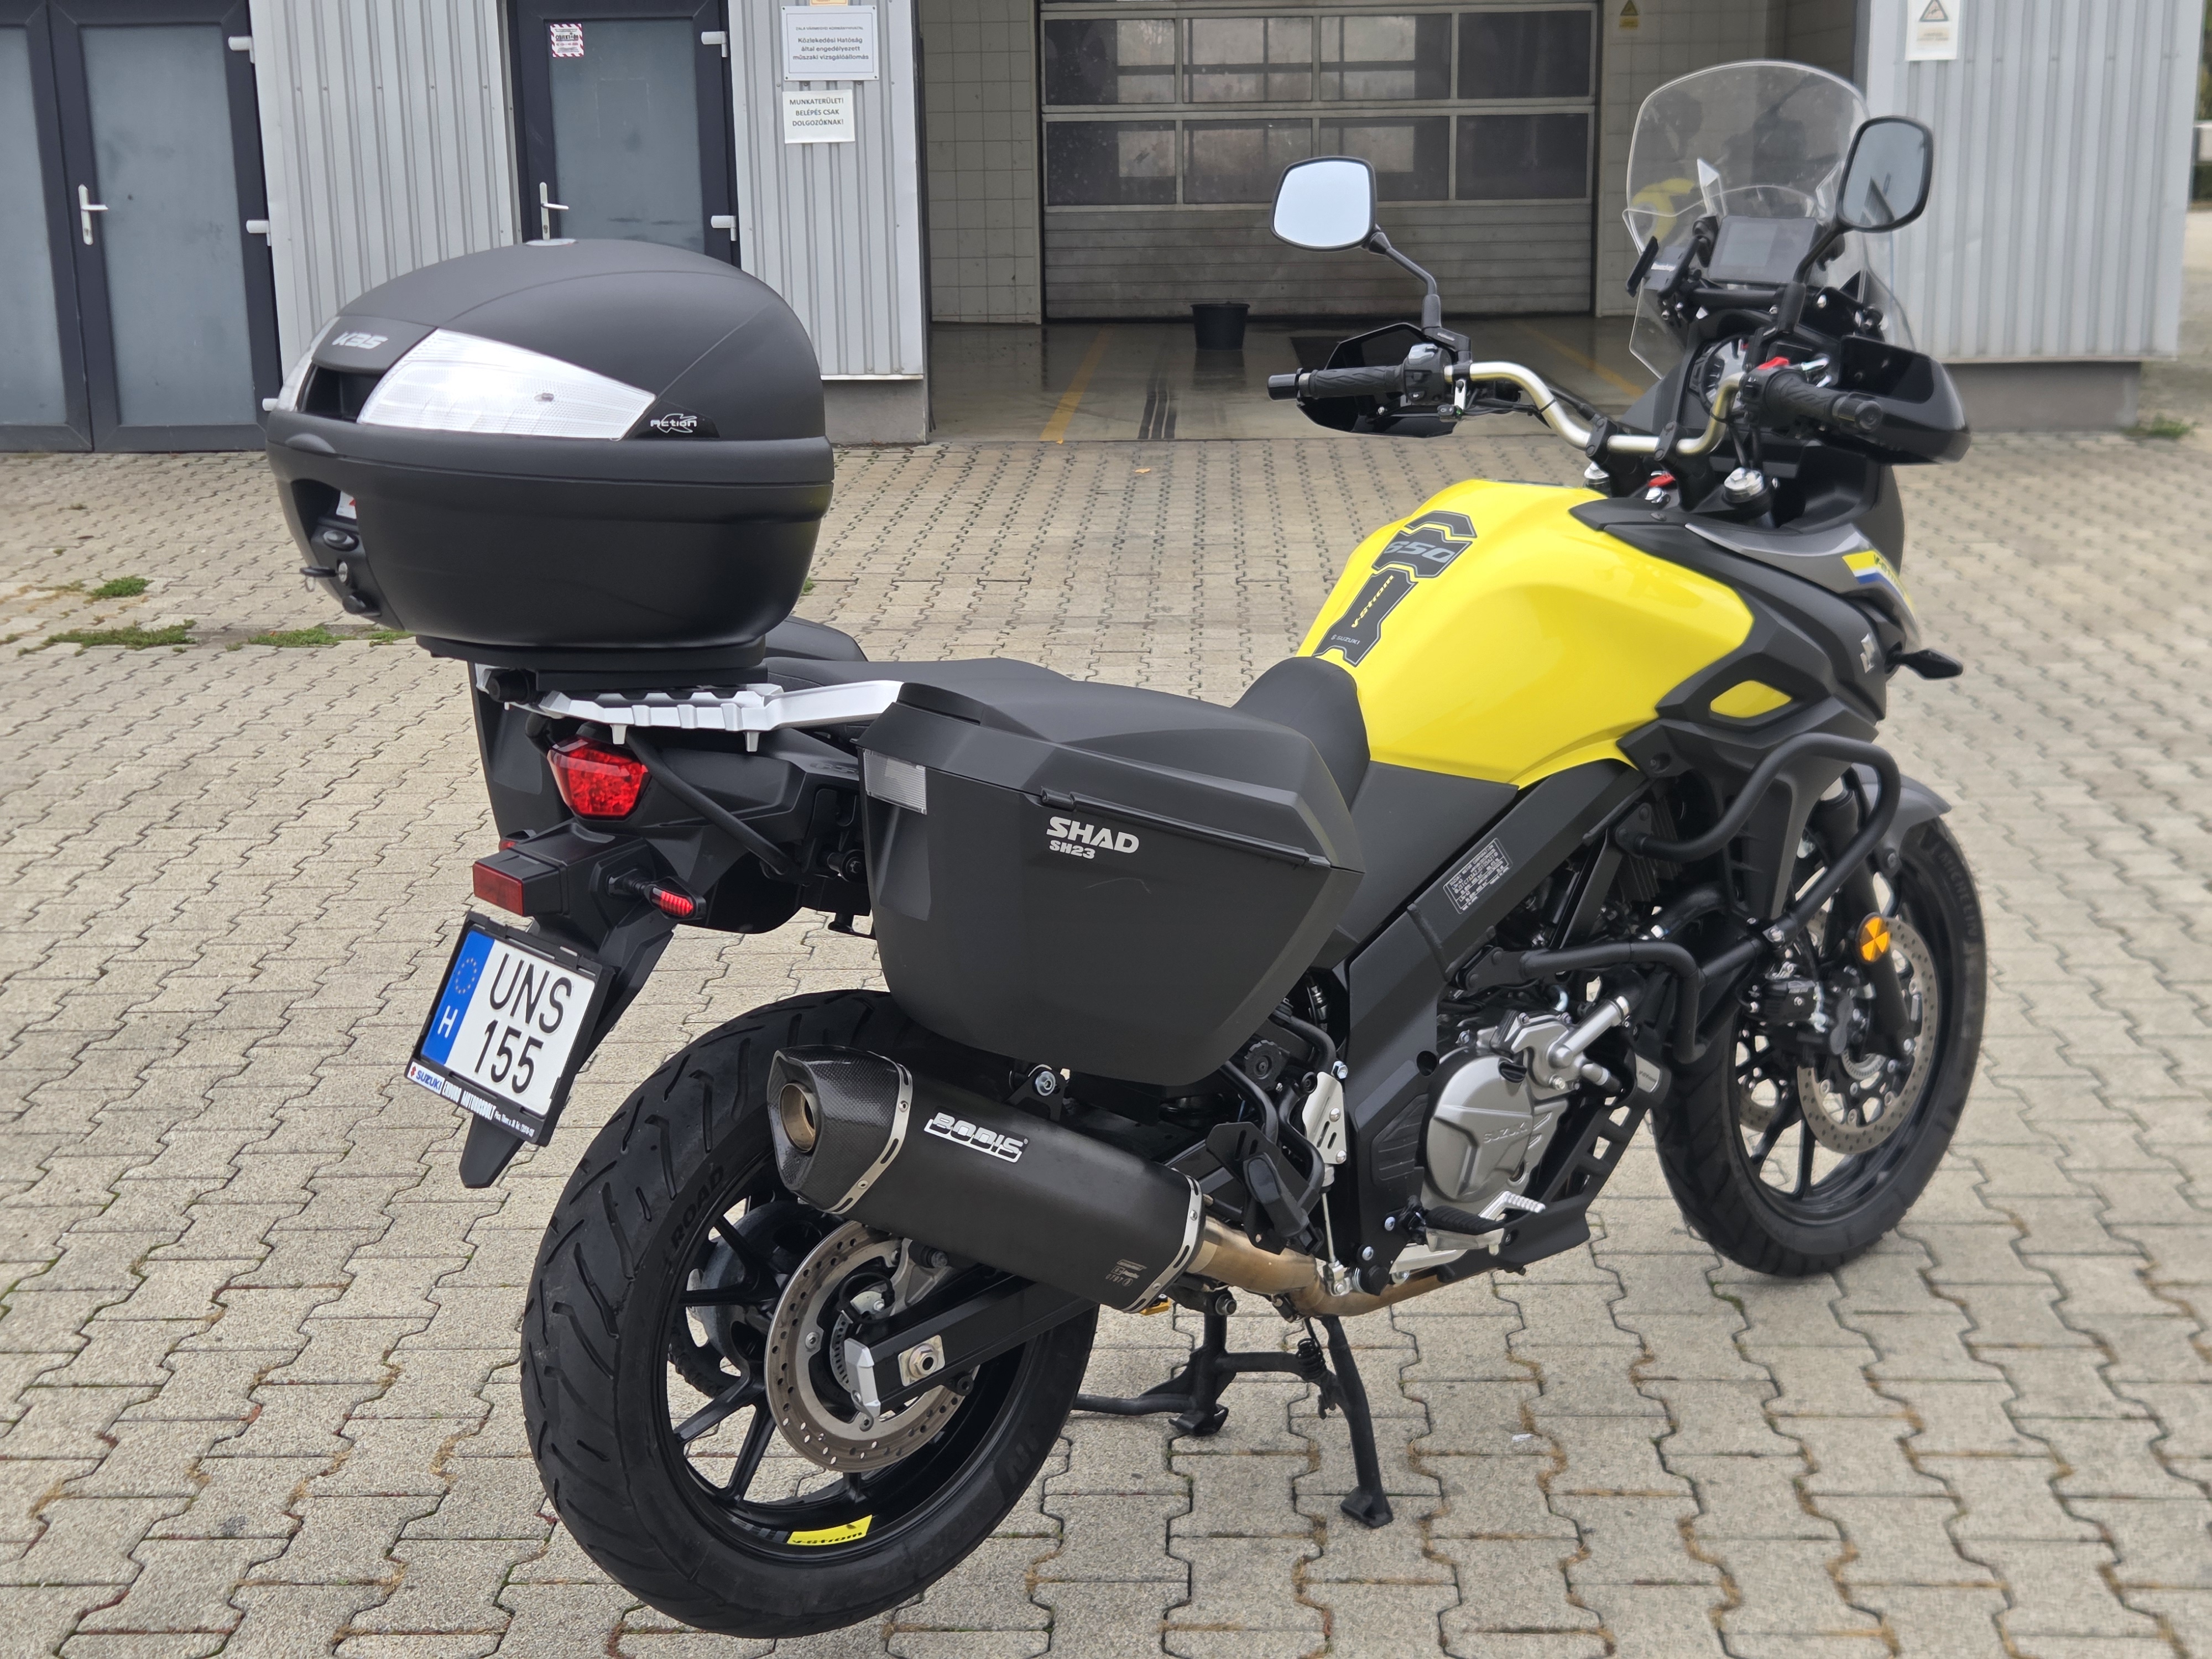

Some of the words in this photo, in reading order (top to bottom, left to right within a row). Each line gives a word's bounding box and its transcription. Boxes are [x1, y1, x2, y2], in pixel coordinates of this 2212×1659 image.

[1383, 541, 1456, 564] 650
[1336, 635, 1360, 645] SUZUKI
[1046, 816, 1139, 853] SHAD
[1049, 839, 1095, 859] SH23
[489, 952, 572, 1034] UNS
[437, 1005, 458, 1038] H
[474, 1019, 544, 1094] 155
[416, 1070, 442, 1091] SUZUKI
[923, 1112, 1024, 1164] BODIS
[1483, 1121, 1528, 1144] SUZUKI
[671, 1164, 724, 1250] ROAD
